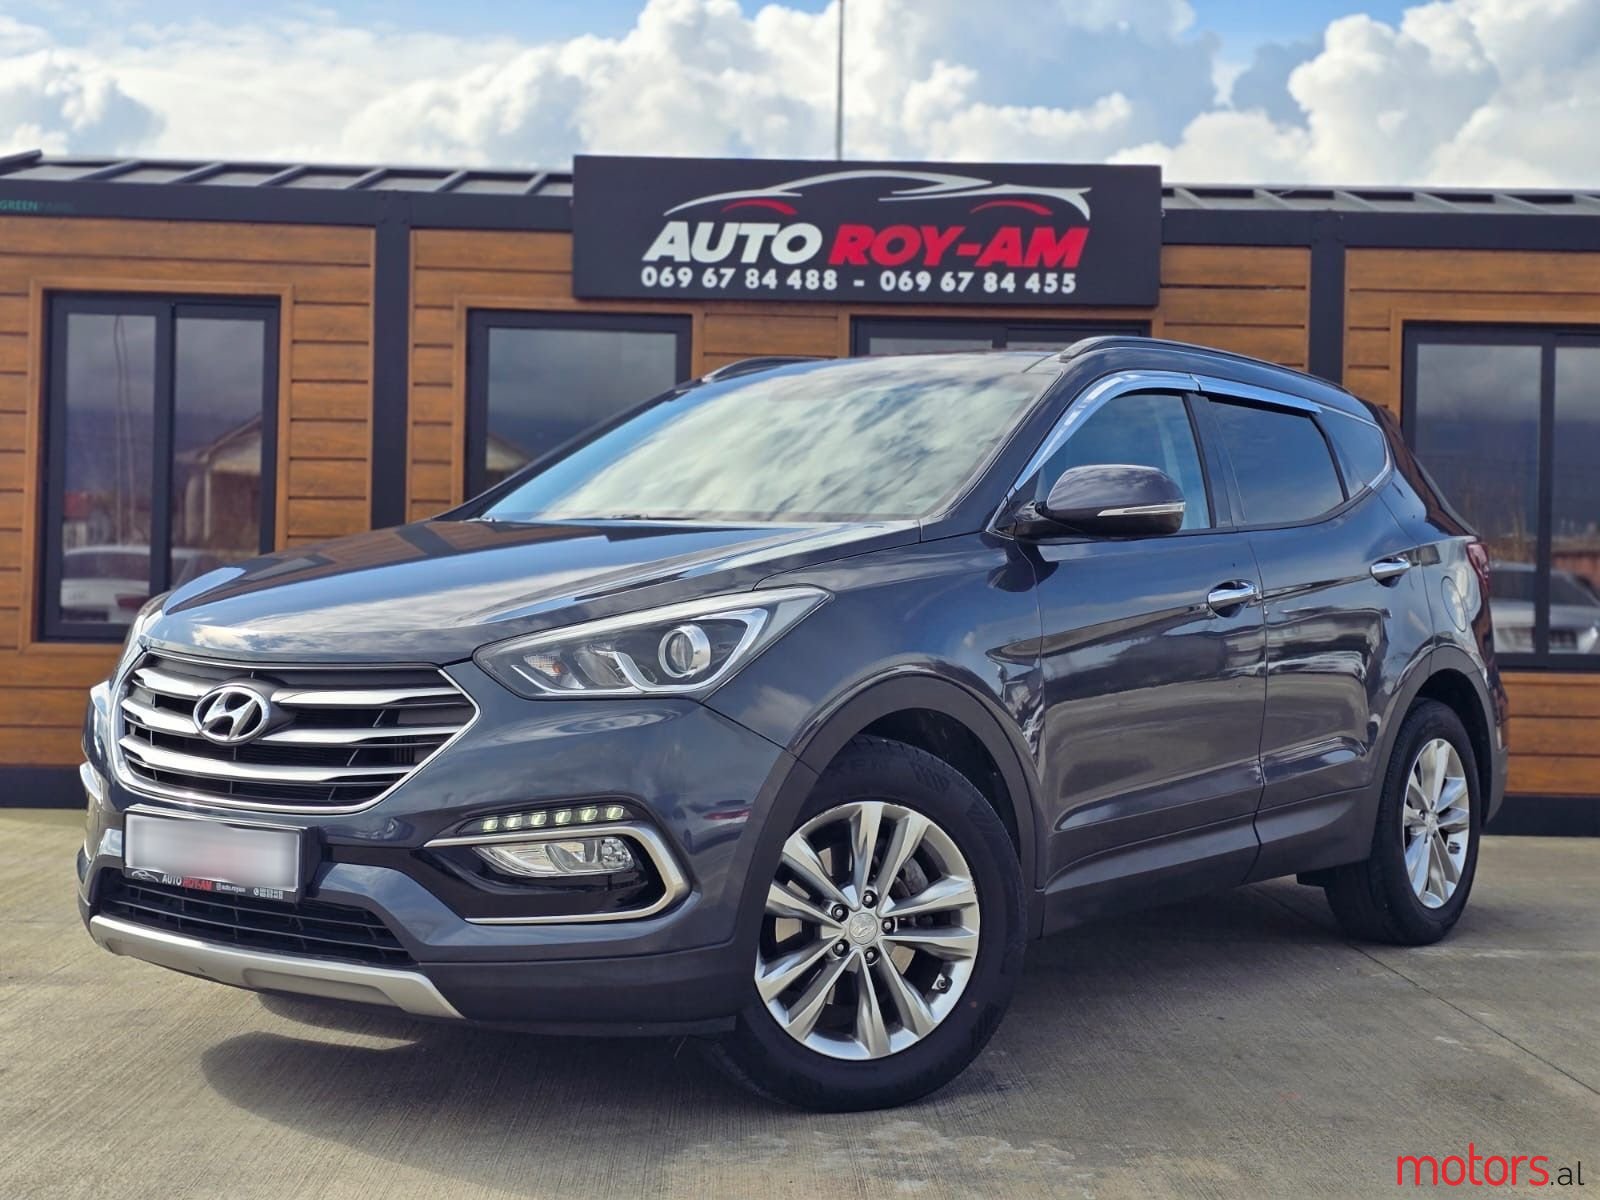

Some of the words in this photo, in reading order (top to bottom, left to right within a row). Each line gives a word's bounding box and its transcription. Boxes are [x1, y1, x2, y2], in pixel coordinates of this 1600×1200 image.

[641, 221, 823, 265] AUTO
[828, 224, 1089, 268] ROY-AM
[641, 266, 693, 288] 069
[702, 267, 736, 289] 67
[745, 268, 778, 290] 84
[786, 269, 838, 291] 488
[880, 270, 932, 292] 069
[940, 271, 975, 293] 67
[983, 272, 1016, 294] 84
[1024, 273, 1076, 294] 455
[162, 874, 181, 886] AUTO
